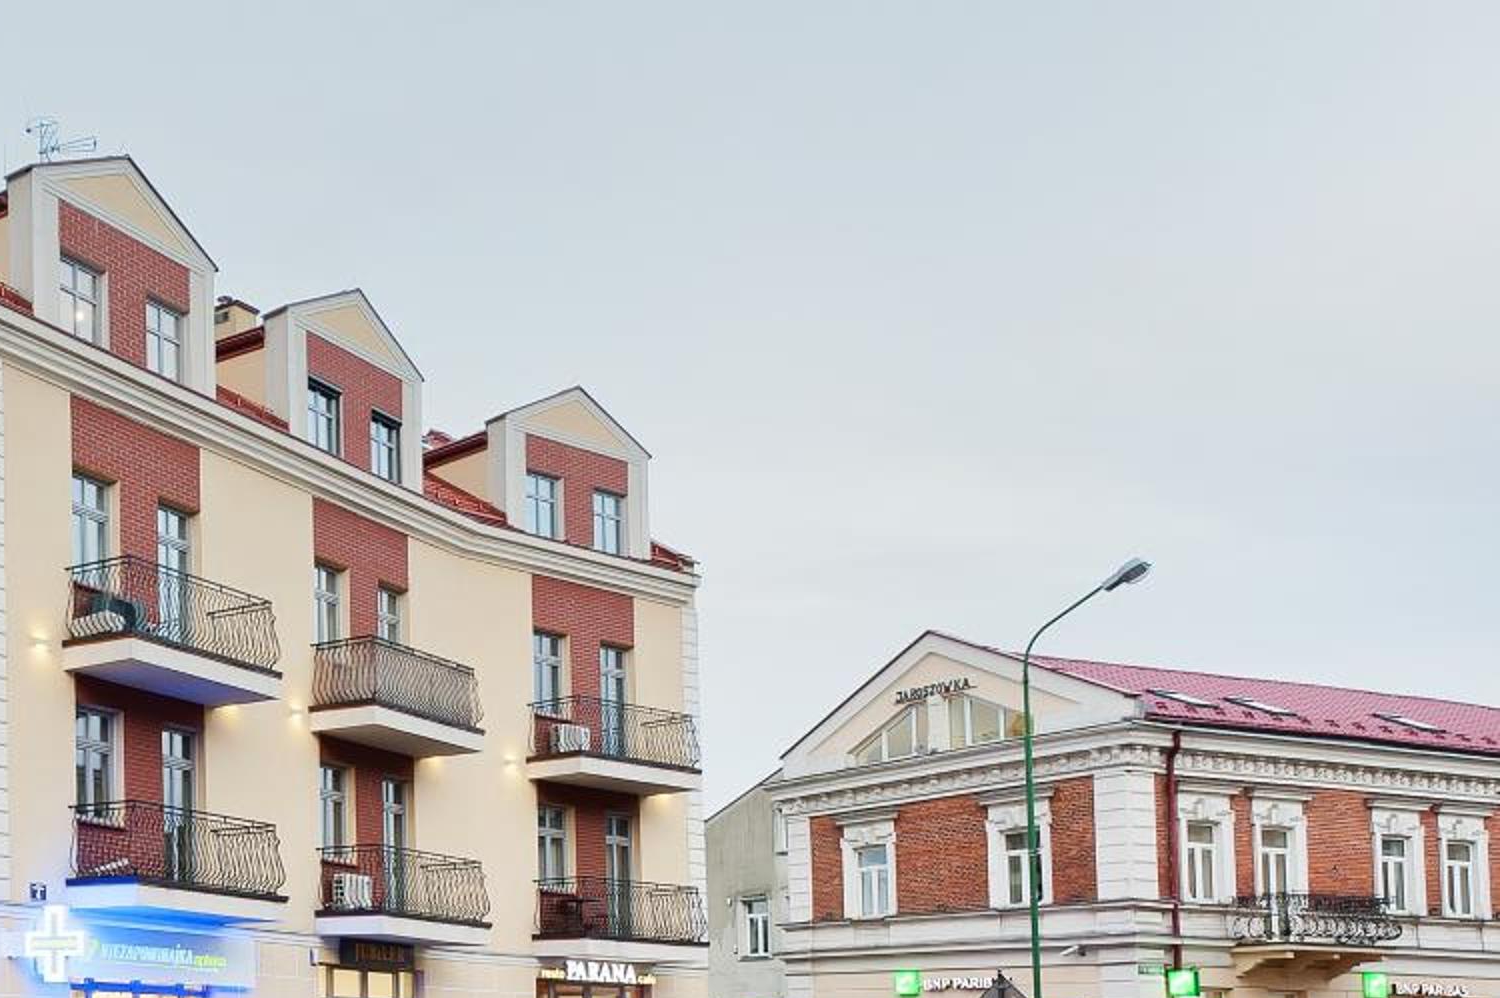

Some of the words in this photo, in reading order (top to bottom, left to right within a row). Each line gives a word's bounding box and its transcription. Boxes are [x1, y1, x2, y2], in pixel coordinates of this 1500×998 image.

[565, 960, 637, 984] PARANA
[924, 977, 950, 991] BNP
[952, 976, 995, 989] PARIB
[1395, 982, 1420, 995] BNP
